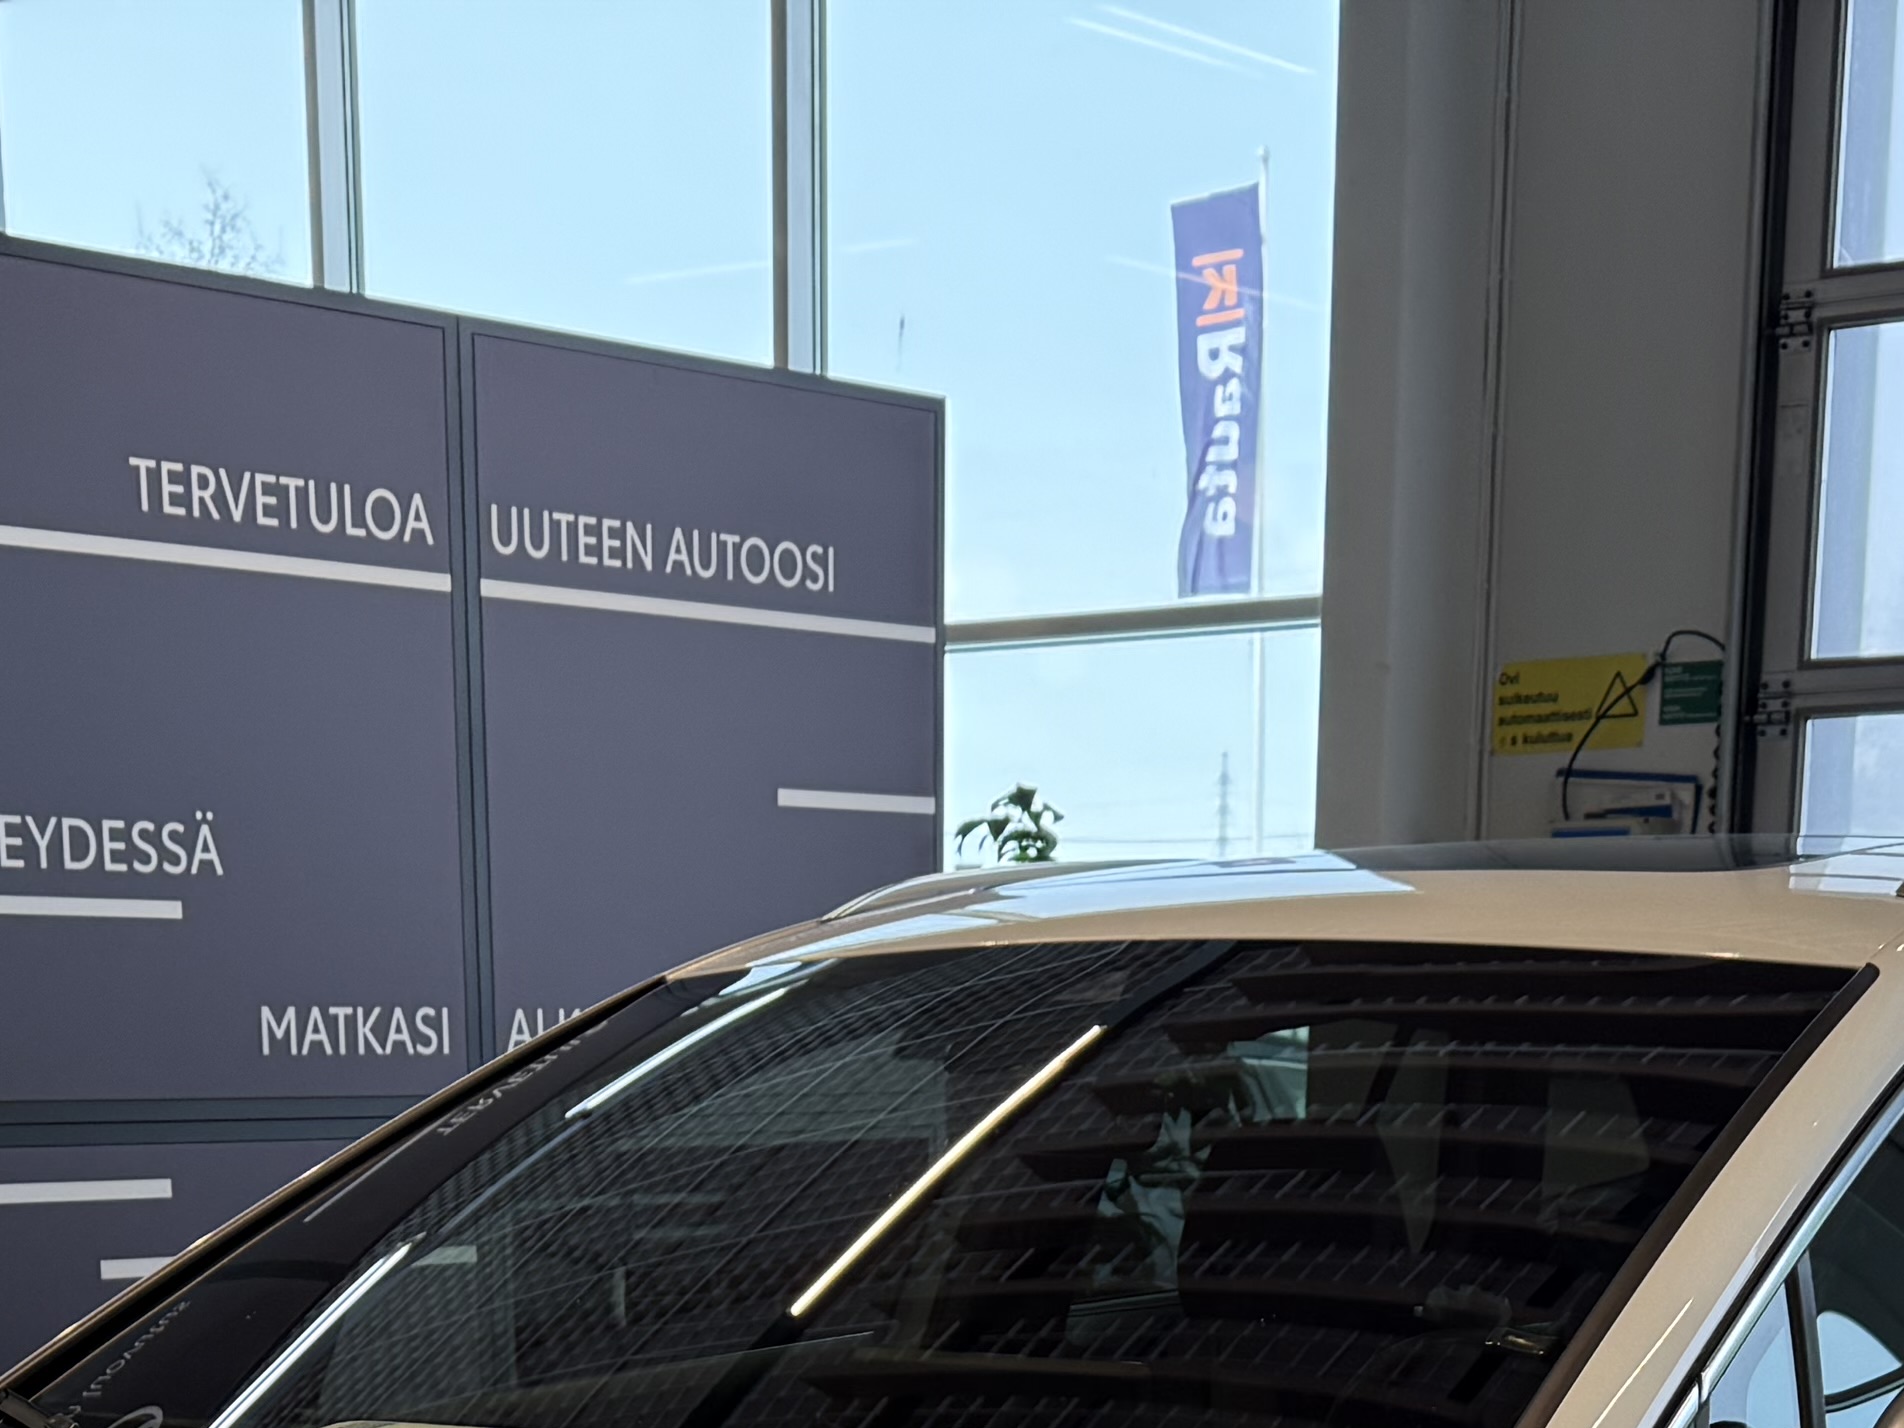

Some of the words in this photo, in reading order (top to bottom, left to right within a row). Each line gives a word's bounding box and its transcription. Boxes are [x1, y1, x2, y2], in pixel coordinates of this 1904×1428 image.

[128, 456, 434, 546] TERVETULOA
[490, 503, 654, 572] UUTEEN
[665, 529, 835, 593] AUTOOSI
[1498, 671, 1521, 686] Ovi
[260, 1005, 450, 1057] MATKASI
